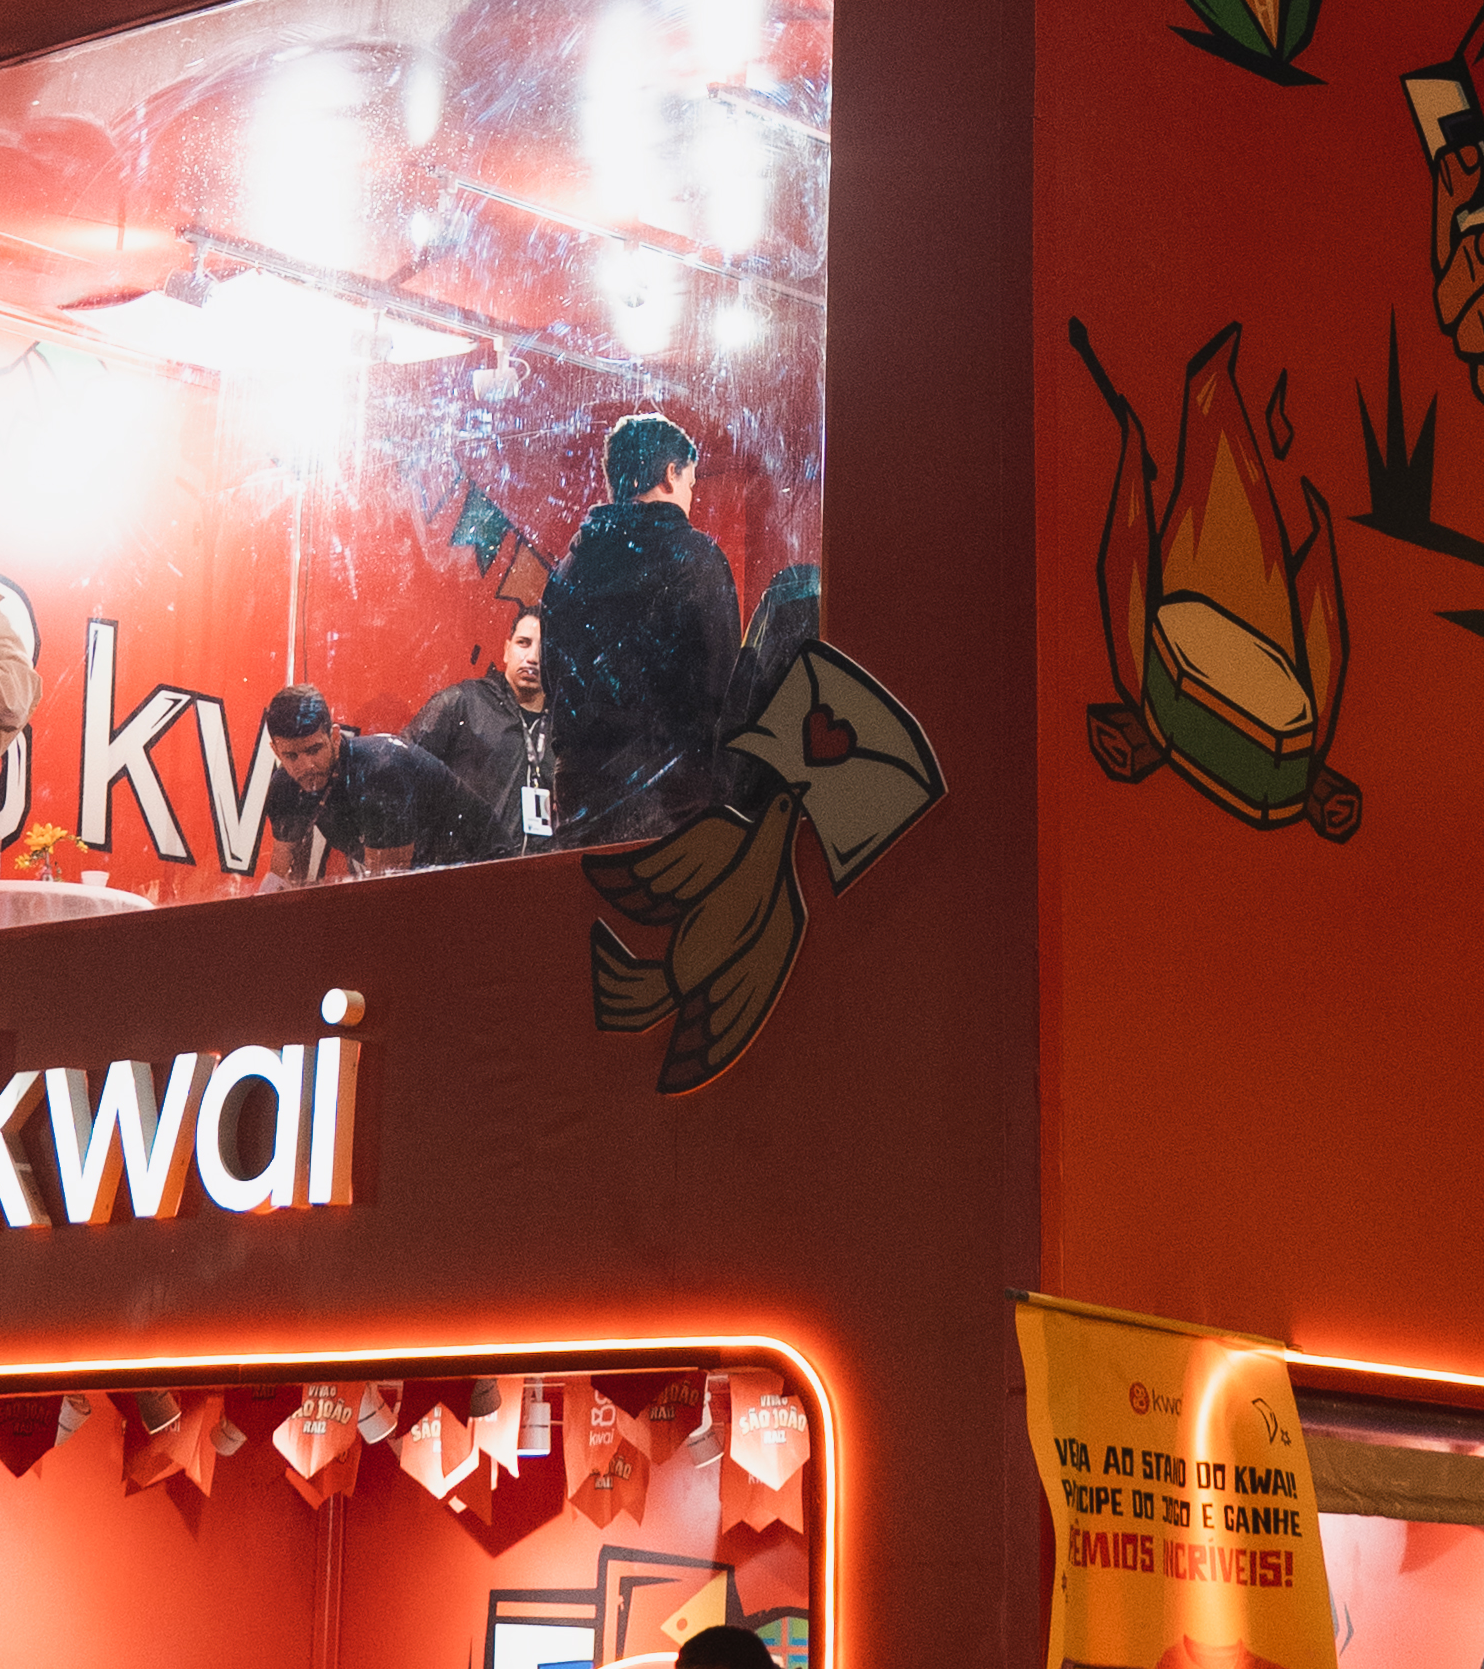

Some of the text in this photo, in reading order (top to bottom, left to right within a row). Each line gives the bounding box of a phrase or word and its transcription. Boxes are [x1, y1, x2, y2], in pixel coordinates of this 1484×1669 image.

[316, 1398, 353, 1425] JOÃO
[739, 1405, 808, 1435] SÃO JOÃO
[303, 1420, 326, 1434] RAIZ
[1103, 1446, 1134, 1477] AO
[1141, 1449, 1186, 1488] STAND
[1196, 1461, 1225, 1491] DO
[1234, 1465, 1298, 1499] KWAI!
[1132, 1489, 1154, 1521] DO
[1202, 1503, 1215, 1529] E
[1224, 1504, 1302, 1538] GANHE
